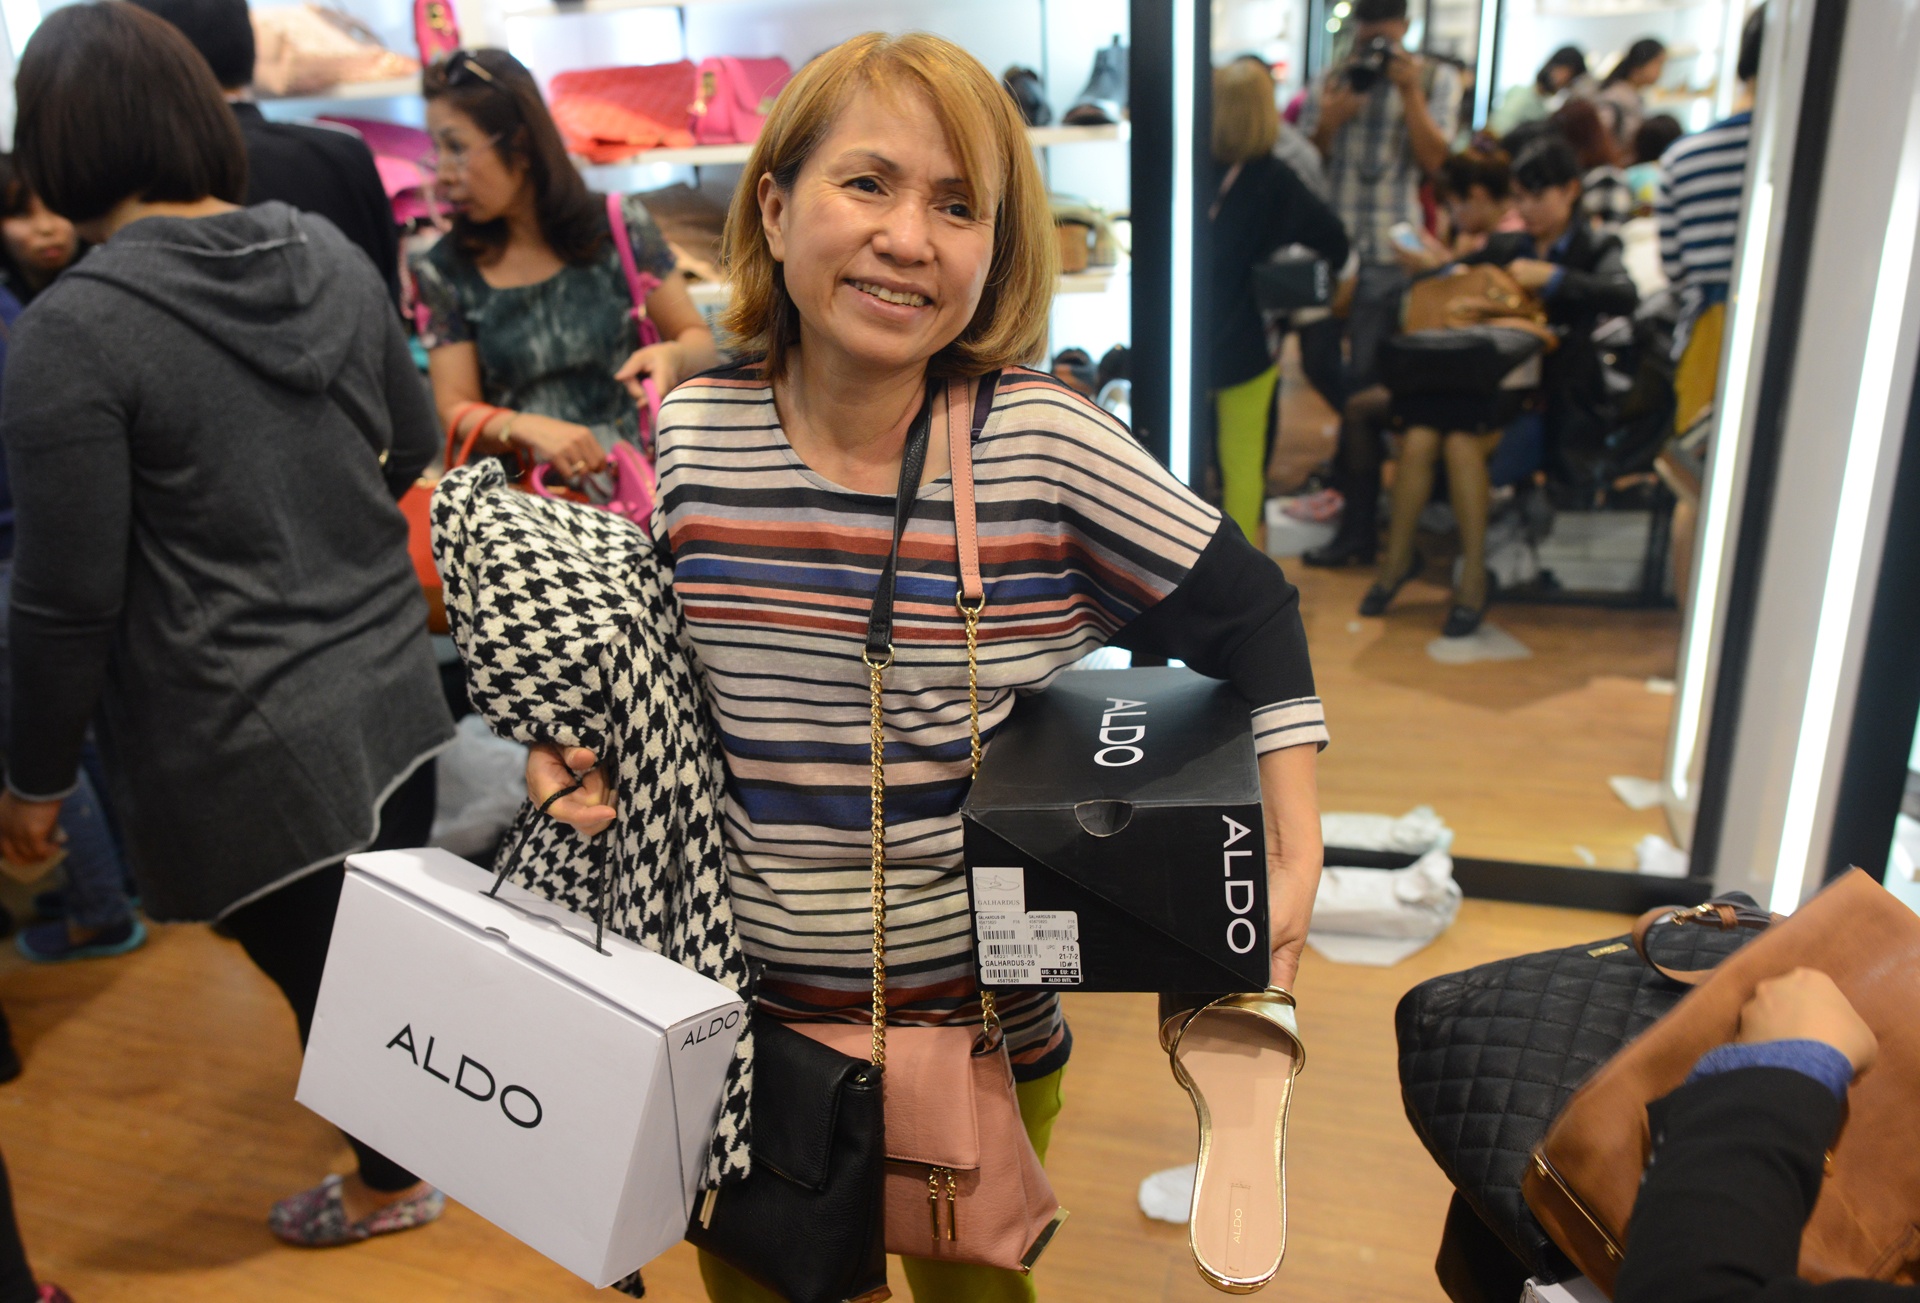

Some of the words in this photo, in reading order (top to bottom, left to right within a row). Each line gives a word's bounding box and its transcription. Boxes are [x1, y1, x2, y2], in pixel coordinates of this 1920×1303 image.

[1094, 697, 1147, 767] ALDO
[1222, 814, 1256, 954] ALDO
[680, 1010, 740, 1050] ALDO
[386, 1023, 543, 1129] ALDO
[1232, 1207, 1243, 1244] ALDO
